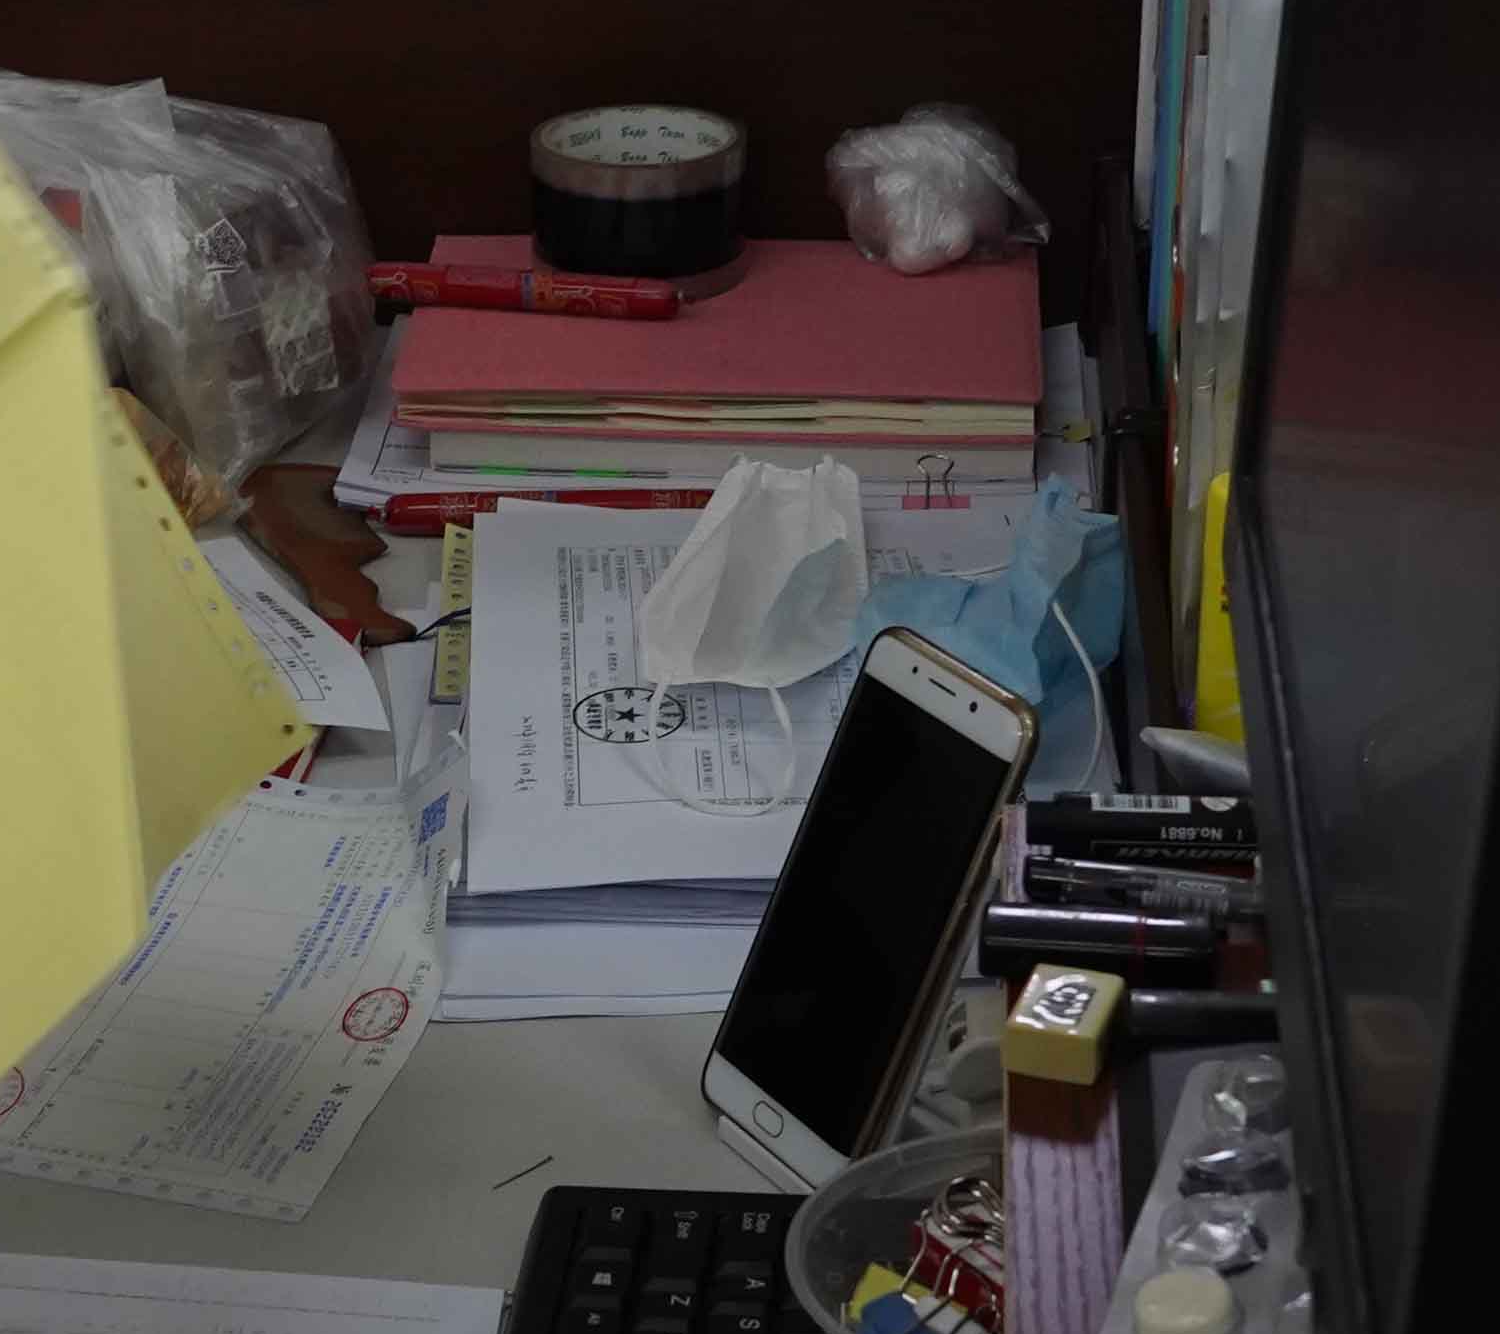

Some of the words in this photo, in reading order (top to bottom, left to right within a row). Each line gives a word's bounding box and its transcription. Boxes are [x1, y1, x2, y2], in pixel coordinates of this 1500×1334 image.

[747, 1277, 766, 1289] A
[670, 1294, 691, 1306] Z
[739, 1318, 761, 1330] S
